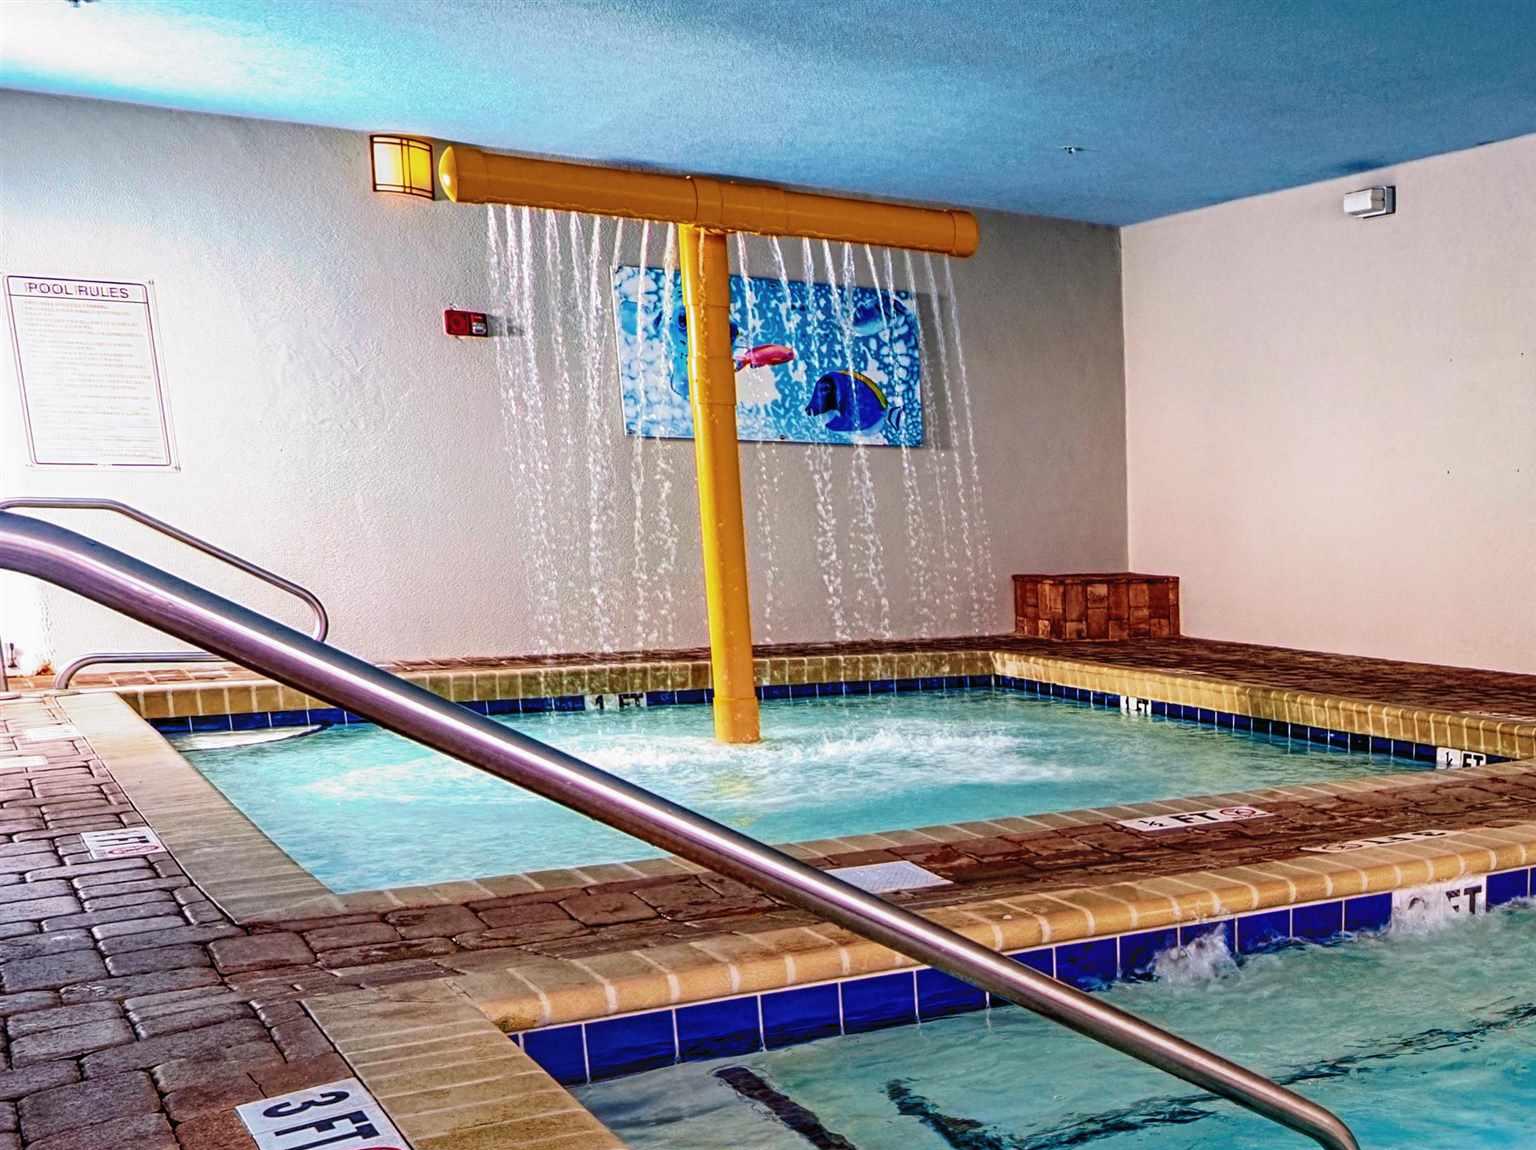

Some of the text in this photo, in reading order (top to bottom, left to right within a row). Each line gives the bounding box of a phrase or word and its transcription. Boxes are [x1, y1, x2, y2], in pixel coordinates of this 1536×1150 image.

[27, 282, 129, 298] POOL RULES
[1169, 812, 1219, 824] FT
[263, 1090, 350, 1118] 3
